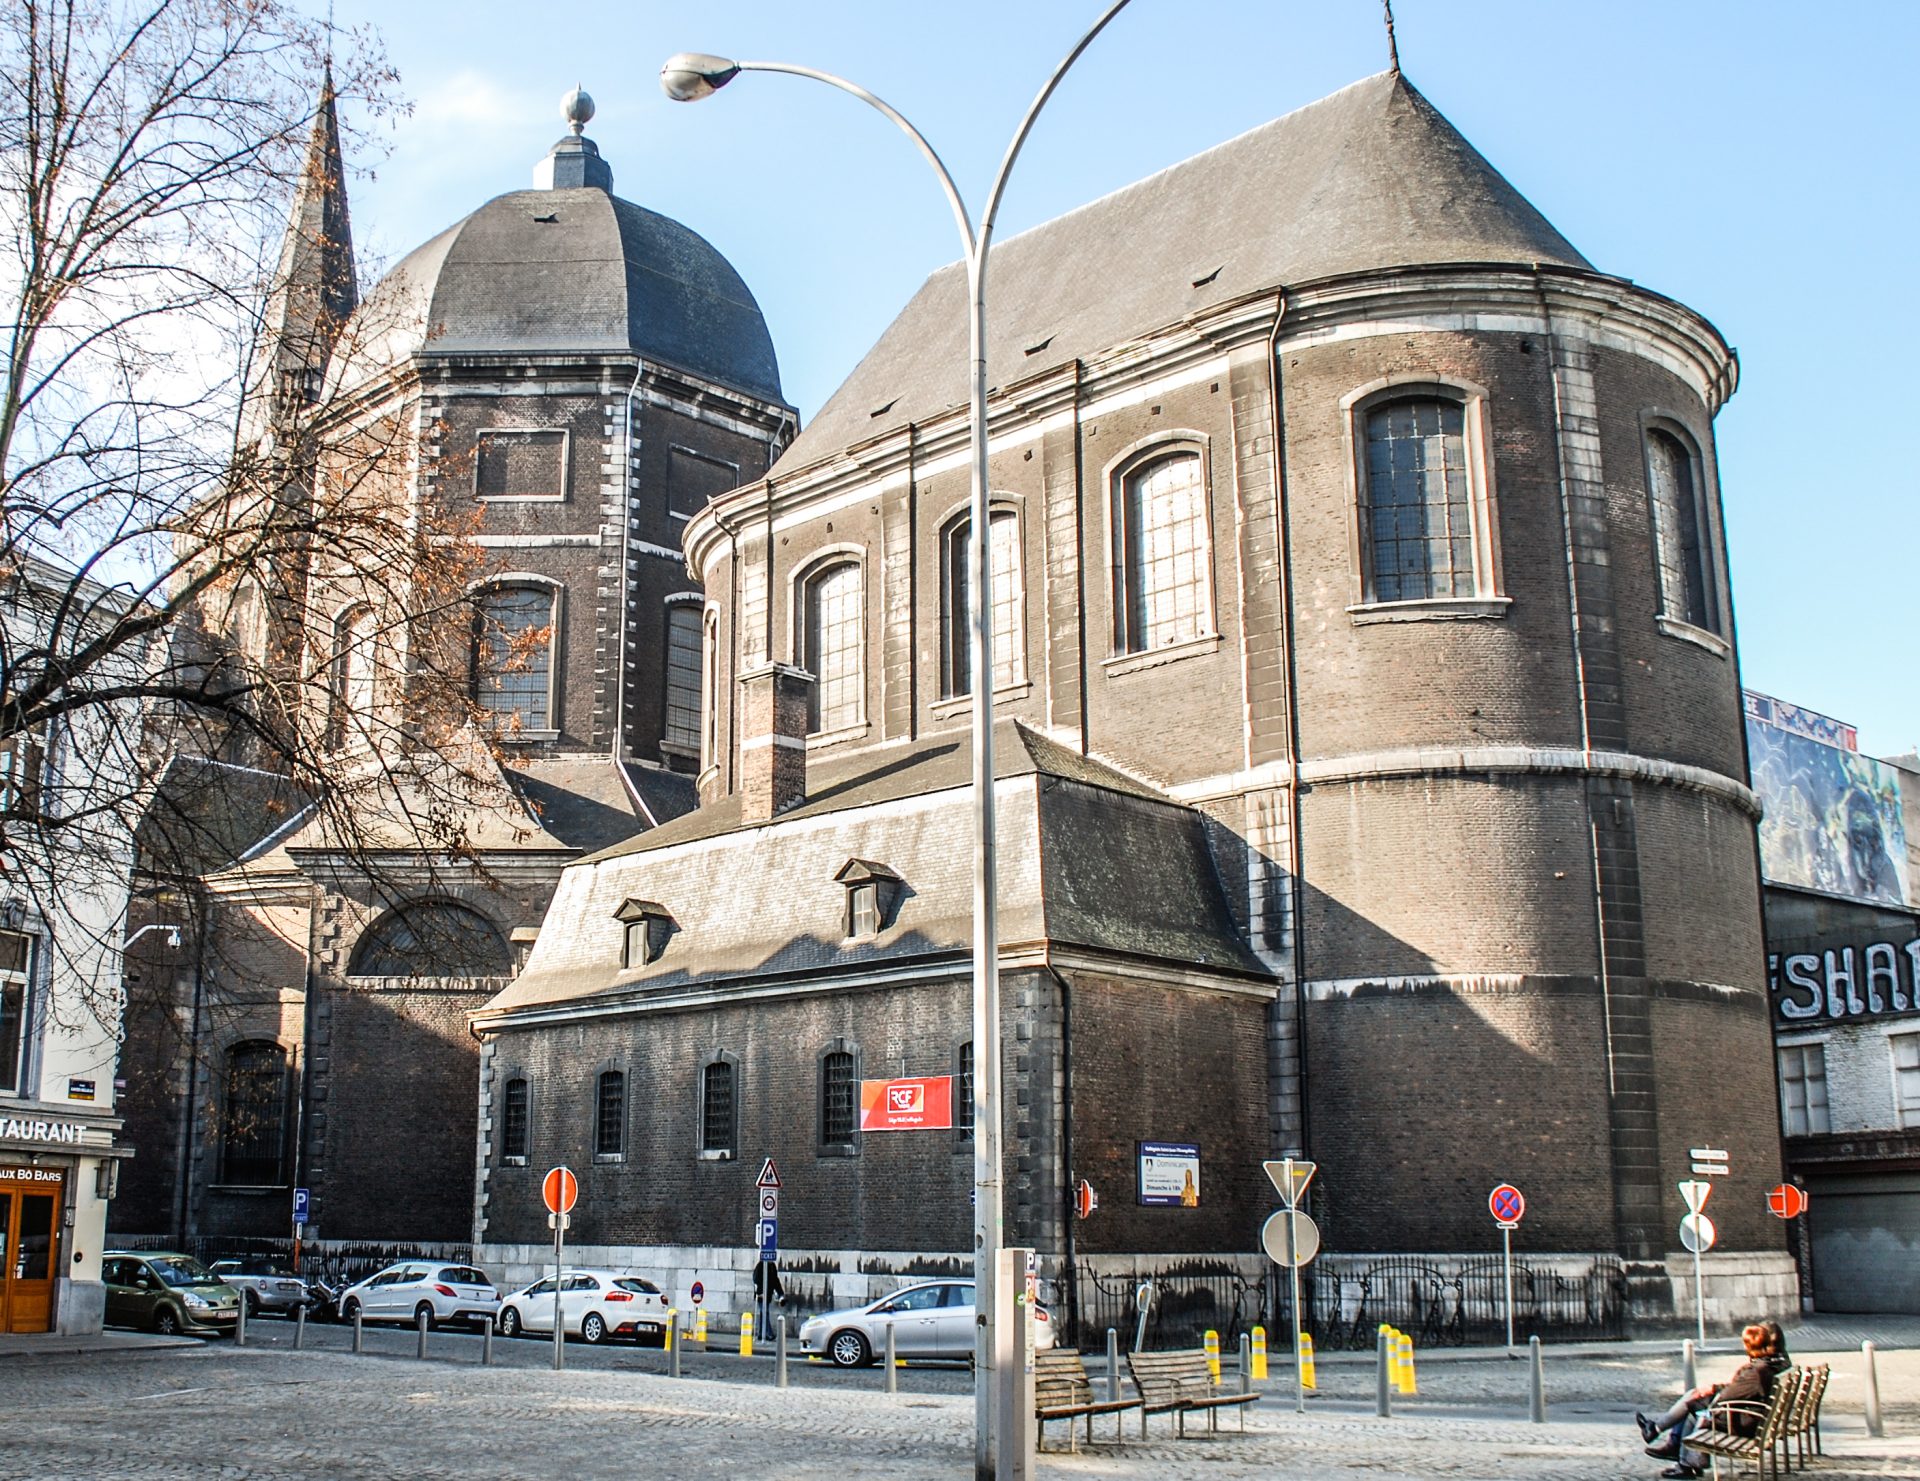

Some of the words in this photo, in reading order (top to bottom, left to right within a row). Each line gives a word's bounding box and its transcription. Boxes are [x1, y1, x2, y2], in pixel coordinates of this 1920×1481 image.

[891, 1090, 913, 1104] RCF
[296, 1193, 306, 1210] P
[762, 1223, 774, 1246] P
